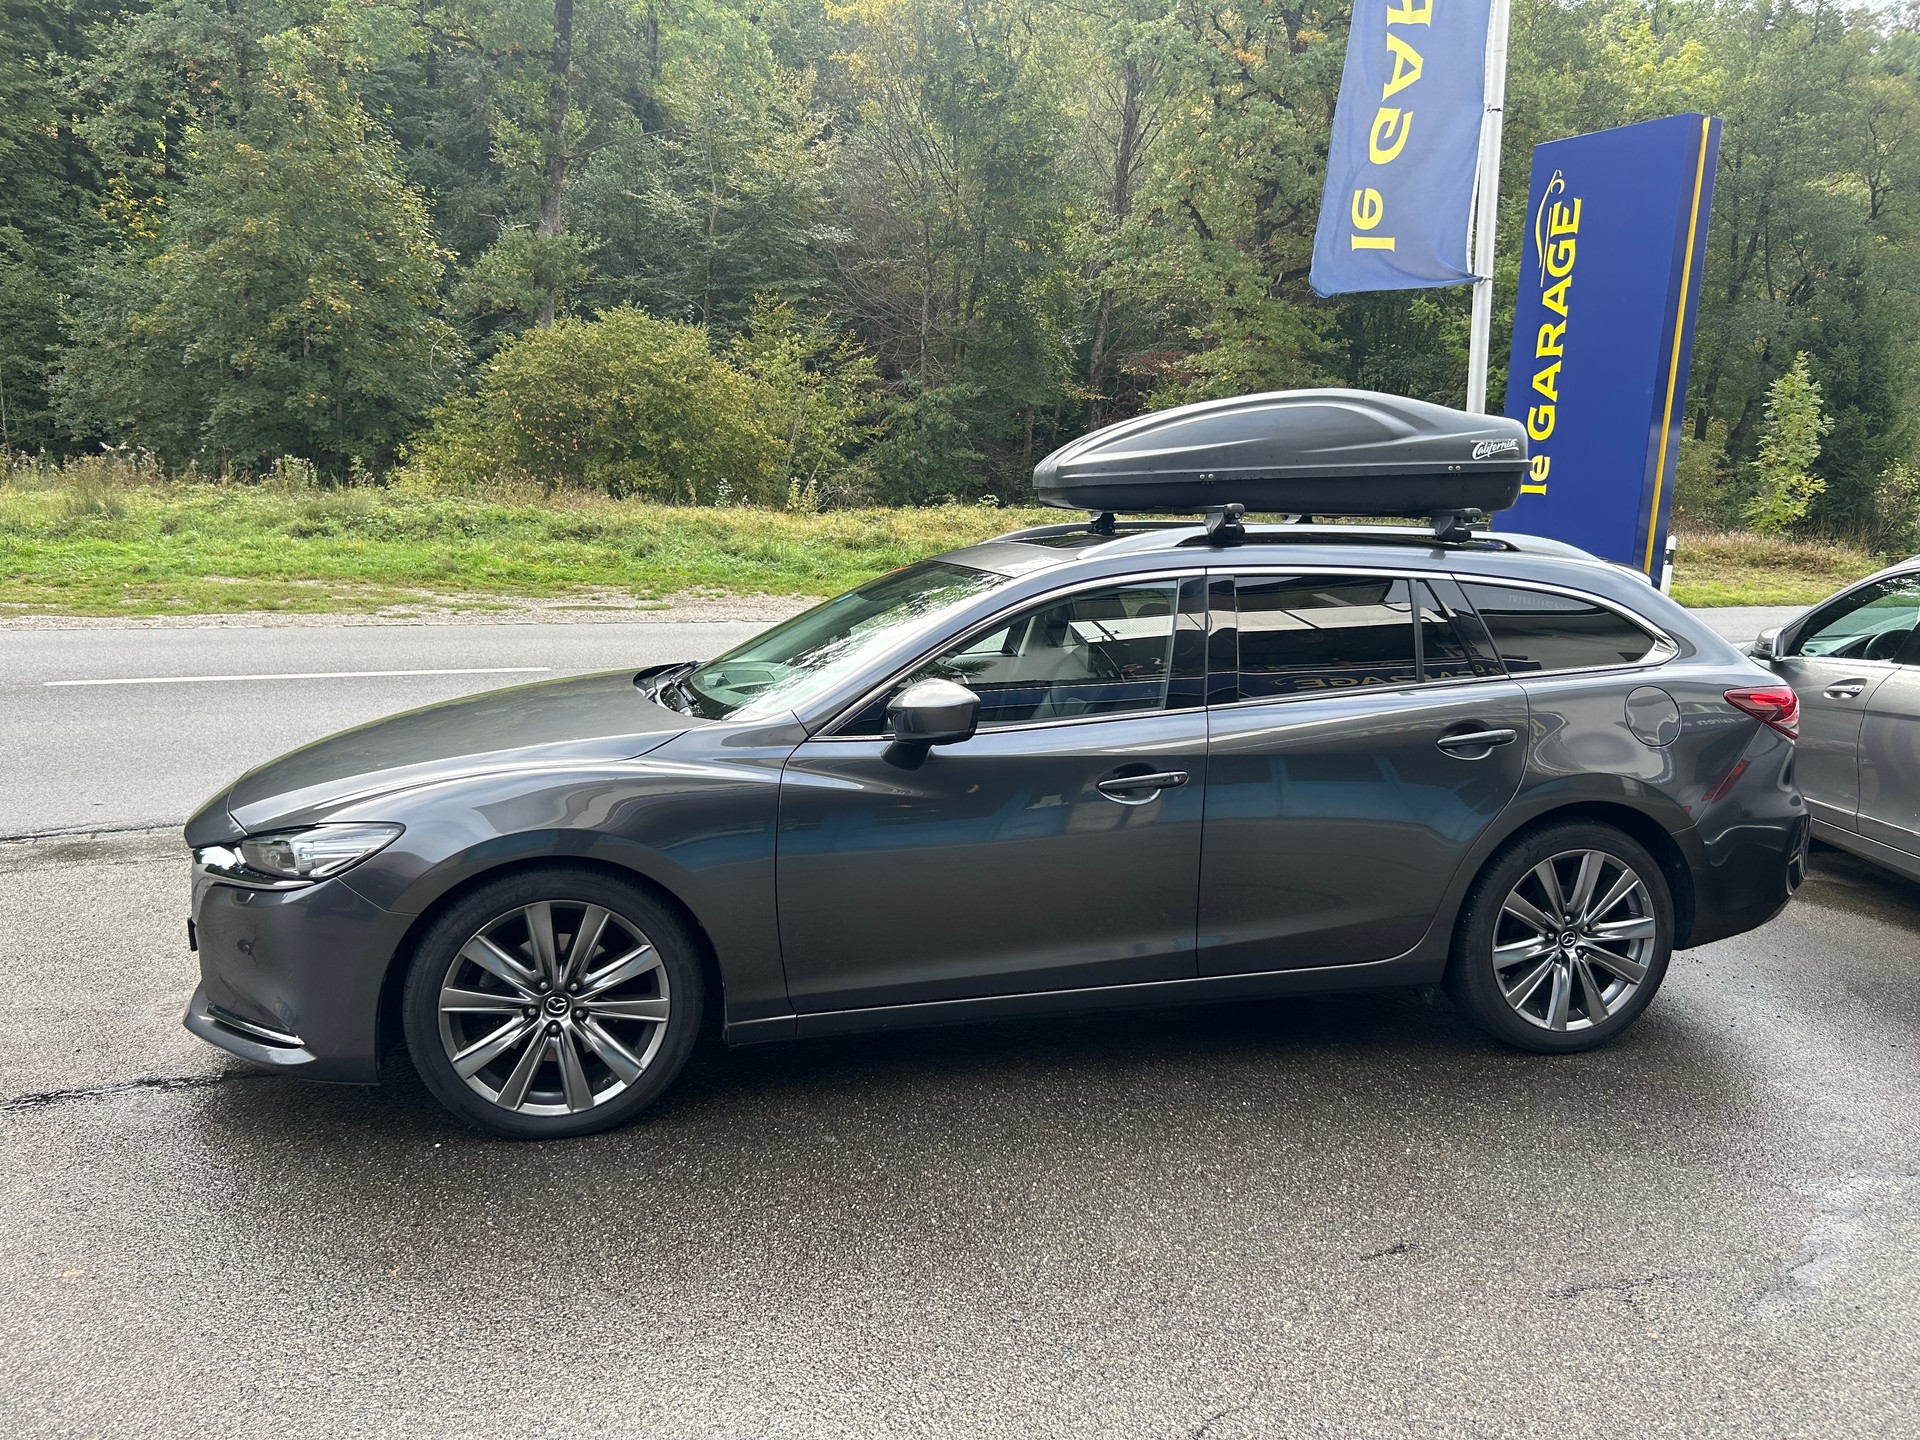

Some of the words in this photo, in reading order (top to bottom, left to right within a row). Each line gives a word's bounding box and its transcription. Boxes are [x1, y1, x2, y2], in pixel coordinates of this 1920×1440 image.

[1527, 197, 1582, 441] GARAGE
[1470, 439, 1519, 460] California
[1520, 455, 1551, 496] le
